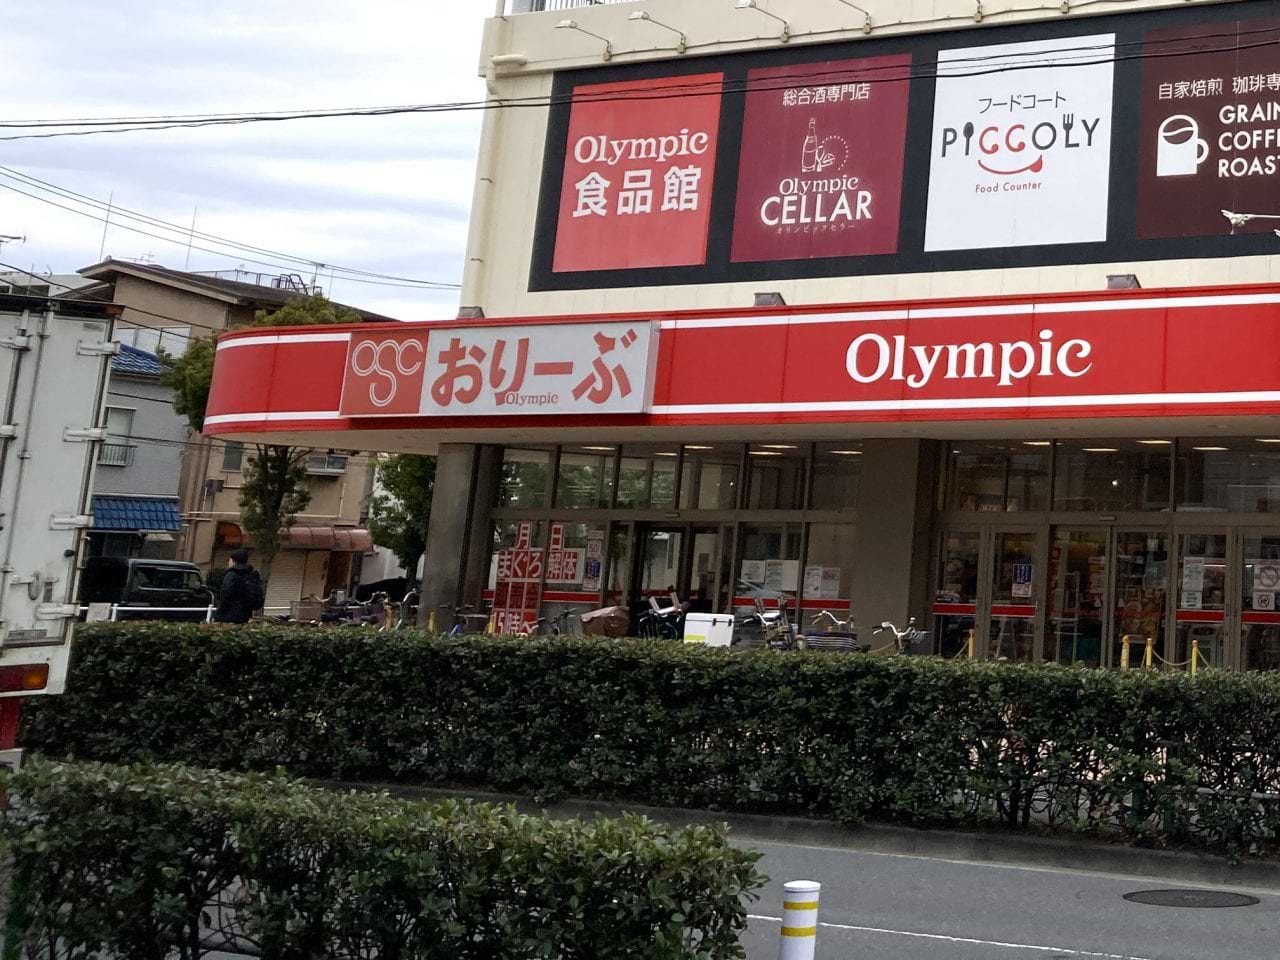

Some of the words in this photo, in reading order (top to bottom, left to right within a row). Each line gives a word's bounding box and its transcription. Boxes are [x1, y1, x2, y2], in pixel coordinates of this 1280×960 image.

[782, 82, 871, 107] 総合酒専門店
[1158, 78, 1223, 100] 自家焙煎
[978, 90, 1067, 114] フードコート
[573, 128, 709, 166] Olympic
[572, 165, 702, 218] 食品館
[778, 174, 860, 197] Olympic
[975, 182, 999, 194] Food
[1003, 181, 1042, 193] Counter
[760, 191, 873, 226] CELLAR
[430, 327, 638, 407] おりーぶ
[845, 329, 1093, 389] Olympic
[505, 390, 560, 407] Olympic
